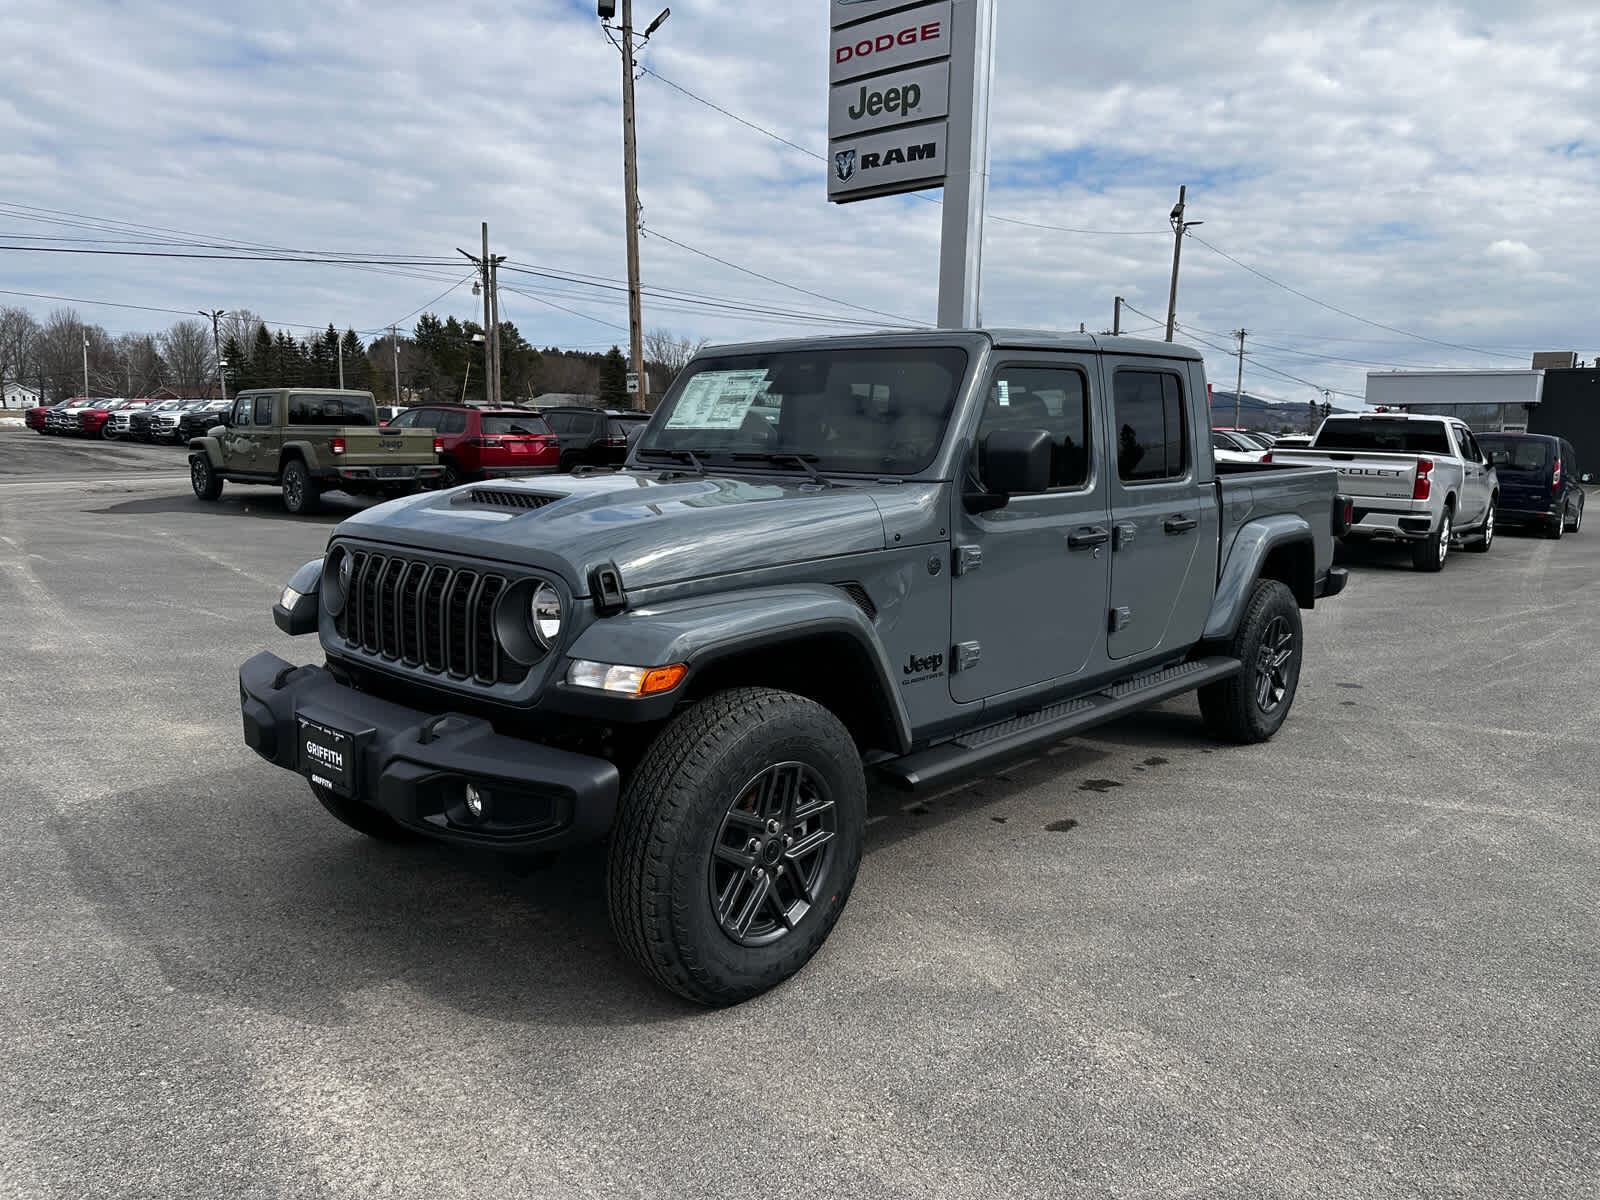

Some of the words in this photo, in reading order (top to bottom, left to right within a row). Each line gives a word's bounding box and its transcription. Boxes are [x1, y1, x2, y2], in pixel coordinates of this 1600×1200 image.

[835, 22, 941, 64] DODGE
[848, 83, 921, 120] Jeep
[861, 142, 937, 170] RAM
[379, 439, 403, 449] Jeep
[903, 653, 943, 673] Jeep
[306, 740, 343, 767] GRIFFITH
